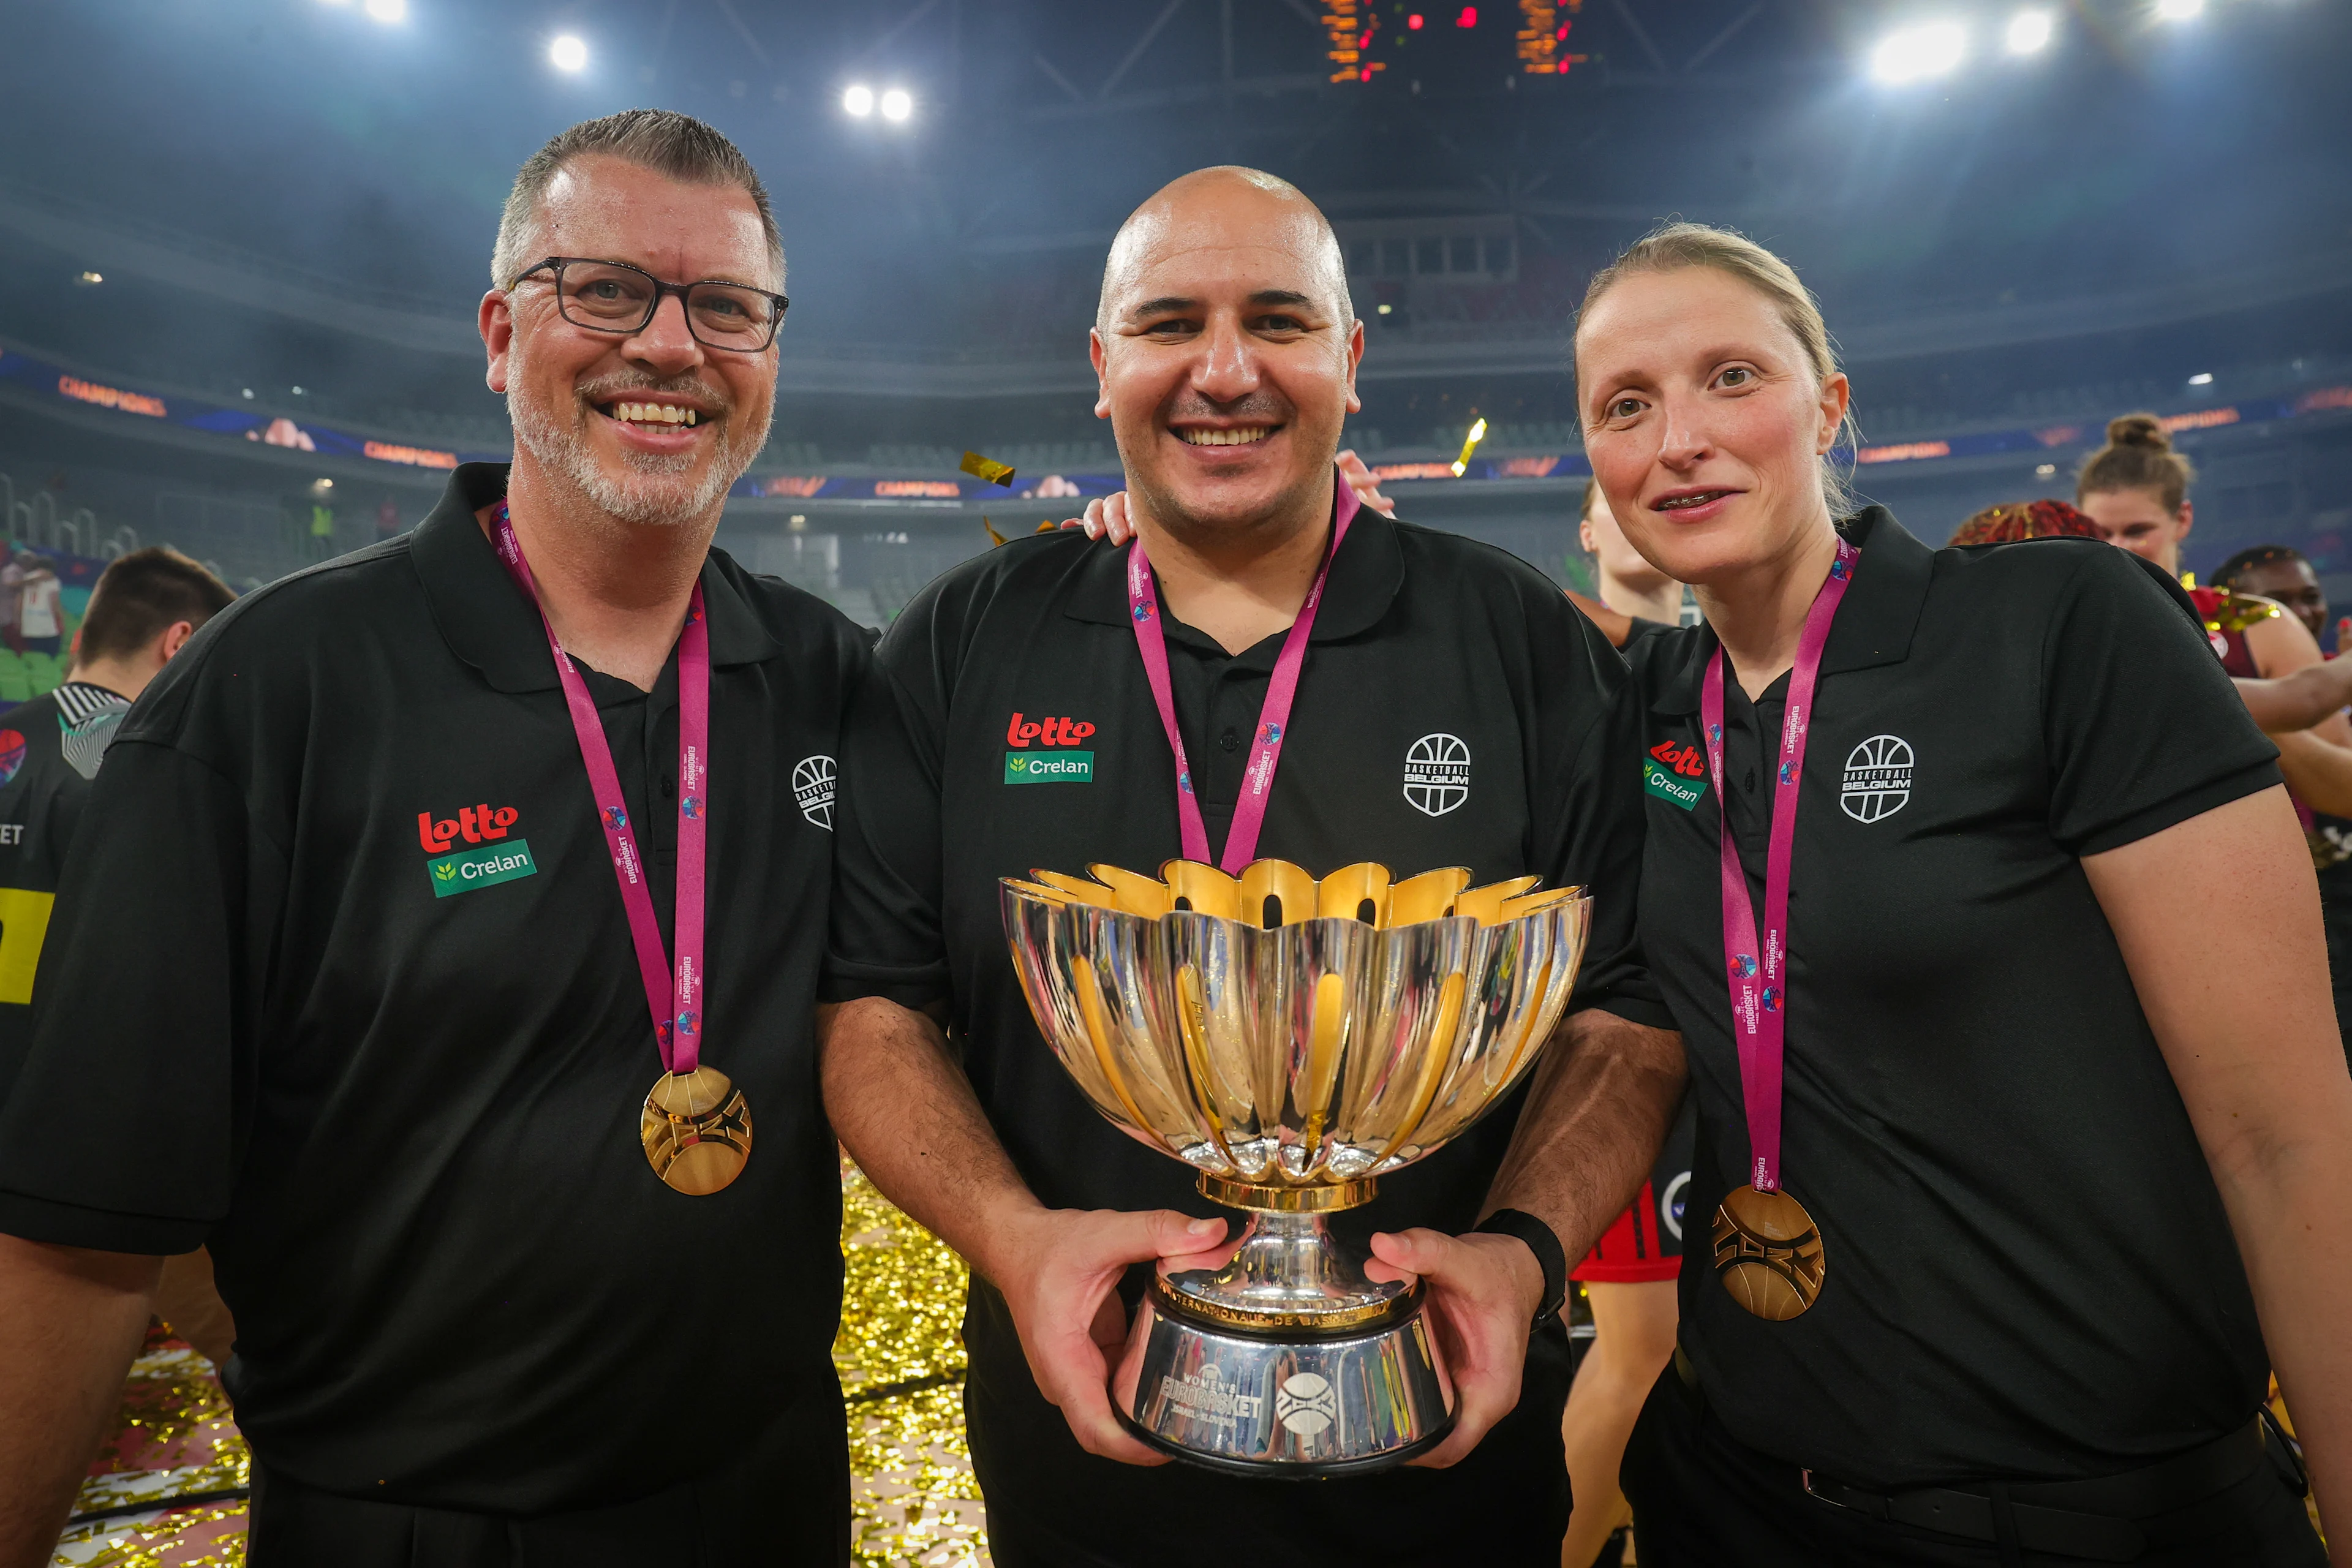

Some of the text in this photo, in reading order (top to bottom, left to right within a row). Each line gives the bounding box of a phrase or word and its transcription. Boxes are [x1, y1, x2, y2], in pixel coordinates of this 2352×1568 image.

[1787, 706, 1800, 755] EUROBASKET
[1029, 759, 1088, 774] Crelan
[1253, 750, 1271, 795] EUROBASKET
[1404, 764, 1469, 775] BASKETBALL
[1404, 774, 1469, 785] BELGIUM
[1842, 769, 1912, 782] BASKETBALL
[1651, 772, 1697, 802] Crelan
[1842, 779, 1912, 791] BELGIUM
[0, 824, 24, 845] ET
[461, 853, 529, 880] Crelan
[618, 836, 638, 884] EUROBASKET
[1768, 929, 1777, 981] EUROBASKET
[683, 956, 692, 1005] EUROBASKET
[1743, 984, 1757, 1035] EUROBASKET
[1273, 1315, 1294, 1326] DE
[1161, 1375, 1262, 1419] EUROBASKET
[1183, 1372, 1236, 1395] WOMEN'S
